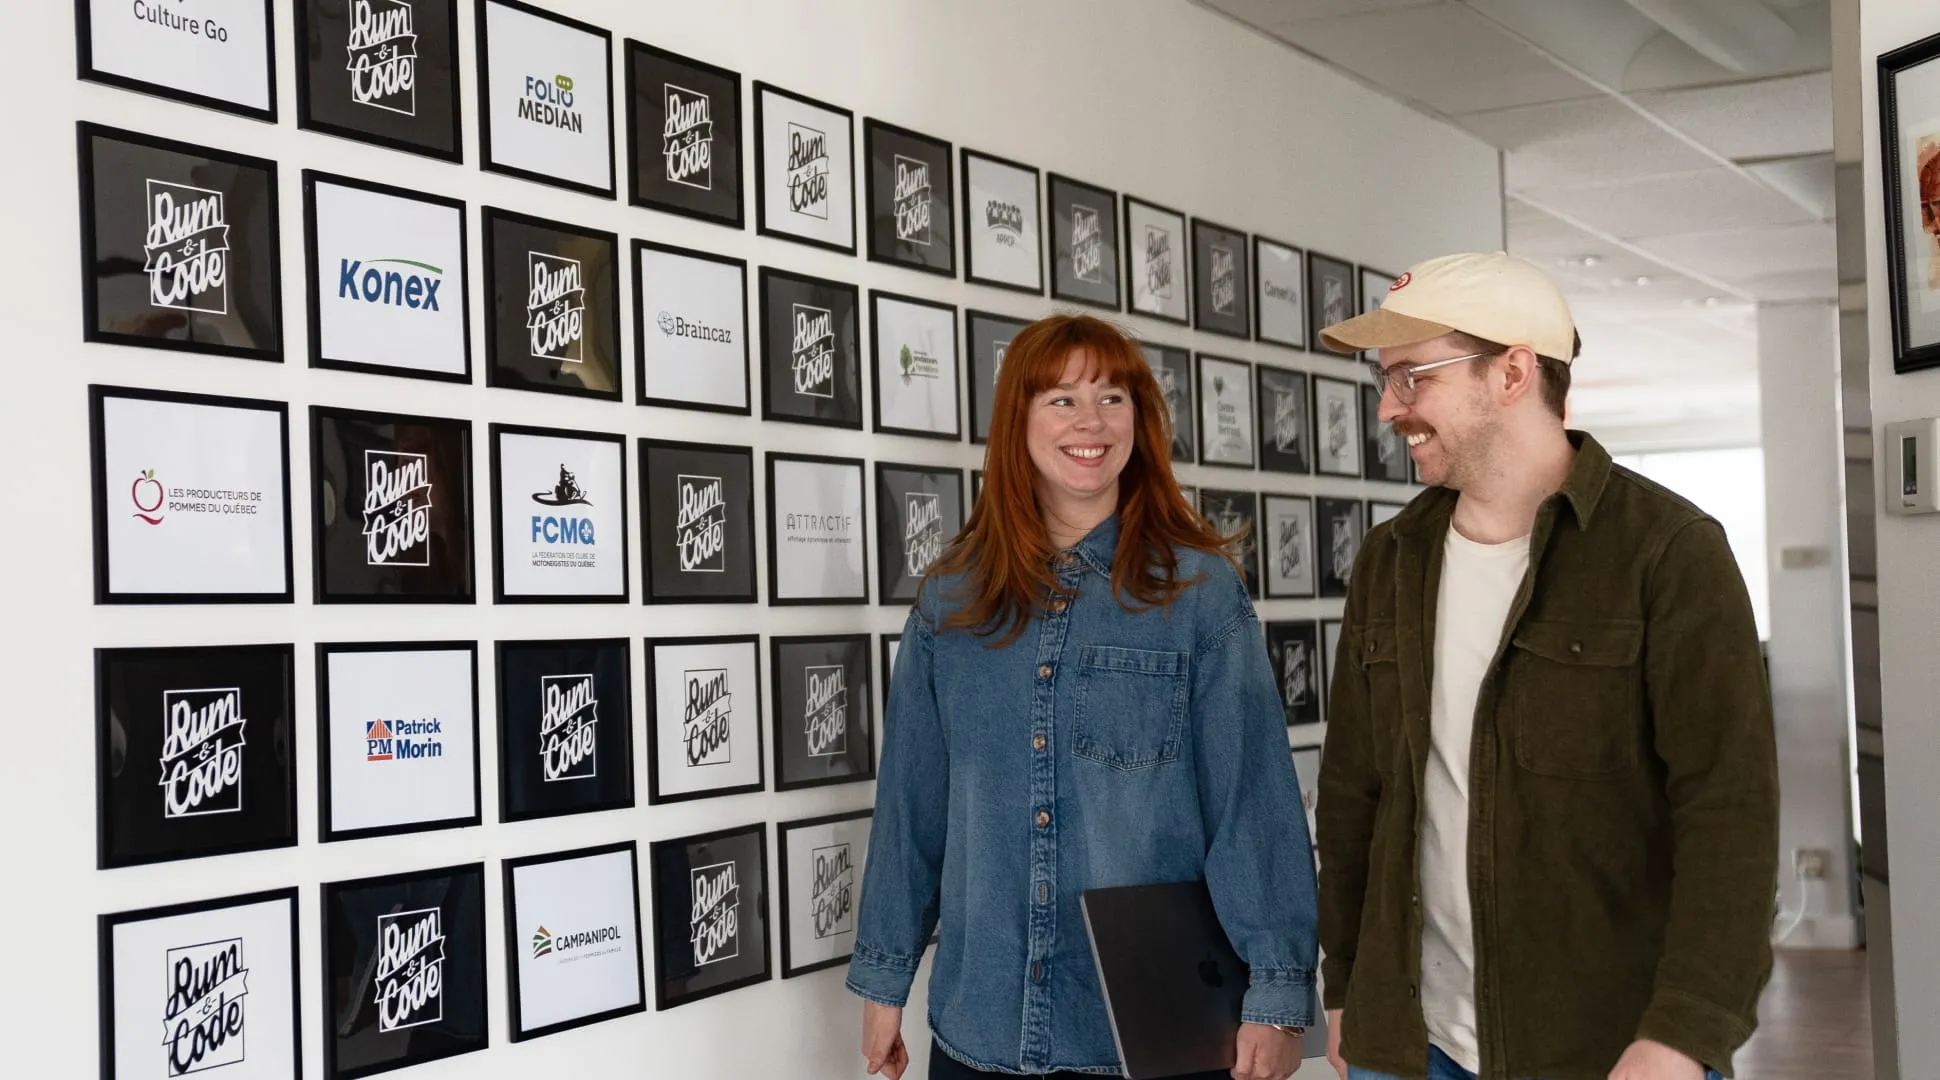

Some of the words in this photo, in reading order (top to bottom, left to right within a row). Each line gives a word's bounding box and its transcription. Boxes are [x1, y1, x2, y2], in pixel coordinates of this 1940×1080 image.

[133, 0, 199, 34] Culture
[204, 19, 228, 42] Go
[349, 0, 412, 50] Rum
[354, 45, 412, 102] Code
[525, 75, 574, 108] FOLIO
[518, 97, 582, 133] MEDIAN
[665, 94, 709, 138] Rum
[668, 130, 710, 180] Code
[789, 132, 825, 171] Rum
[791, 166, 827, 212] Code
[895, 163, 928, 201] Rum
[146, 191, 222, 250] Rum
[898, 195, 929, 239] Code
[153, 238, 224, 306] Code
[339, 258, 441, 312] Konex
[529, 261, 579, 306] Rum
[532, 300, 581, 355] Code
[675, 316, 732, 344] Braincaz
[794, 312, 831, 351] Rum
[795, 344, 832, 392] Code
[168, 488, 184, 498] LES
[186, 489, 249, 501] PRODUCTEURS
[250, 492, 262, 502] DE
[169, 502, 206, 513] POMMES
[208, 503, 221, 513] DU
[222, 503, 257, 515] QUÉBEC
[365, 459, 427, 514] Rum
[679, 481, 721, 528] Rum
[370, 498, 428, 563] Code
[531, 515, 595, 545] FCMQ
[681, 515, 722, 570] Code
[786, 513, 851, 531] ATTRACTIF
[906, 498, 938, 539] Rum
[909, 527, 940, 575] Code
[542, 678, 593, 735] Rum
[685, 672, 728, 724] Rum
[806, 669, 843, 717] Rum
[163, 692, 238, 761] Rum
[367, 739, 392, 755] PM
[395, 718, 442, 735] Patrick
[396, 738, 442, 759] Morin
[546, 715, 593, 779] Code
[688, 708, 729, 765] Code
[809, 701, 844, 754] Code
[168, 738, 239, 815] Code
[692, 865, 735, 923] Rum
[812, 847, 850, 899] Rum
[695, 902, 737, 963] Code
[815, 881, 850, 937] Code
[377, 912, 439, 981] Rum
[556, 925, 621, 952] CAMPANIPOL
[166, 943, 241, 1021] Rum
[382, 955, 440, 1029] Code
[170, 991, 243, 1074] Code
